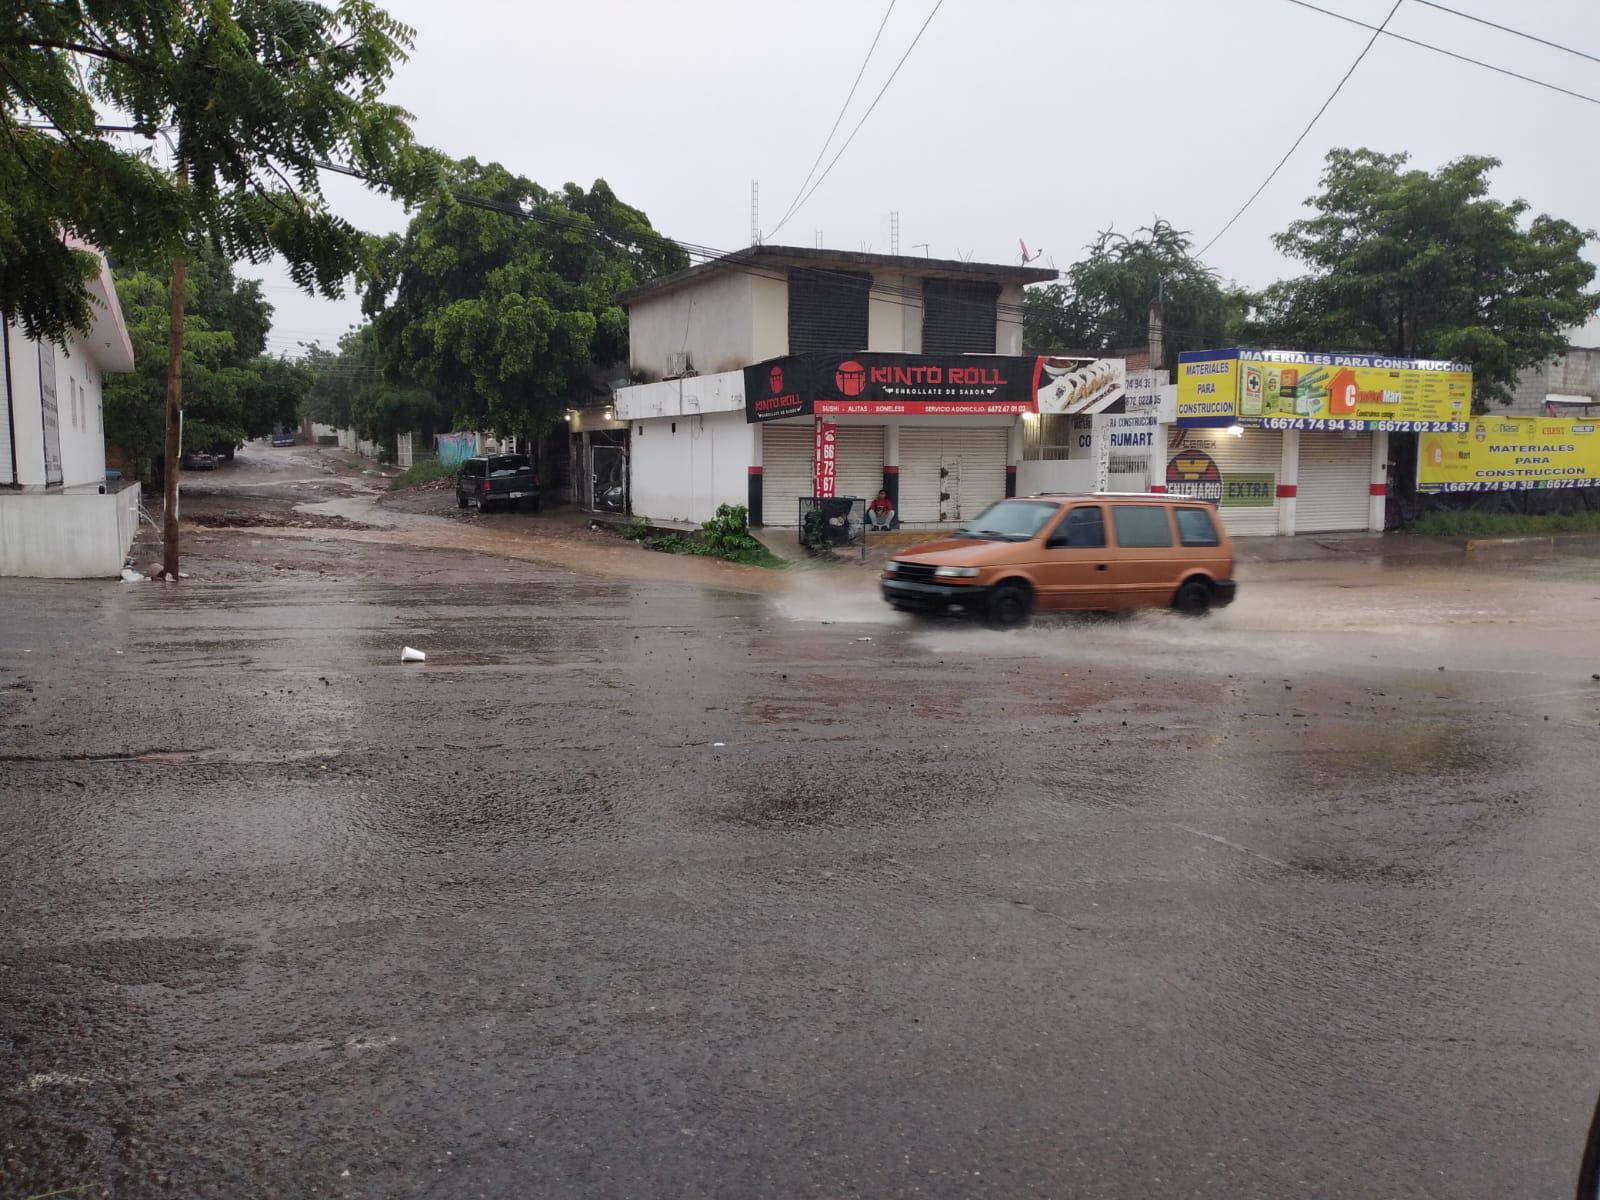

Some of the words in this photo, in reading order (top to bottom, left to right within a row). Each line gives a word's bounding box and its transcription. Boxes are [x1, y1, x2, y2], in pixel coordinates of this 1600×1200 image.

[1240, 350, 1331, 365] MATERIALES
[1335, 357, 1370, 367] PARA
[1186, 362, 1229, 375] MATERIALES
[870, 366, 942, 386] KINTO
[948, 367, 1008, 385] ROLL
[1197, 383, 1216, 394] PARA
[1270, 419, 1304, 430] 6674
[1309, 420, 1324, 430] 74
[1328, 420, 1345, 430] 94
[1348, 421, 1364, 431] 38
[1378, 421, 1410, 431] 6672
[1413, 422, 1429, 431] 02
[1432, 422, 1448, 431] 24
[1451, 422, 1466, 432] 35
[823, 444, 835, 459] 66
[1489, 444, 1575, 453] MATERIALES
[823, 461, 834, 475] 72
[823, 477, 834, 491] 67
[1228, 483, 1269, 497] EXTRA
[1450, 482, 1481, 492] 6674
[1484, 482, 1499, 491] 74
[1502, 481, 1517, 490] 94
[1519, 480, 1534, 490] 38
[1546, 479, 1574, 488] 6672
[1577, 478, 1591, 487] 02
